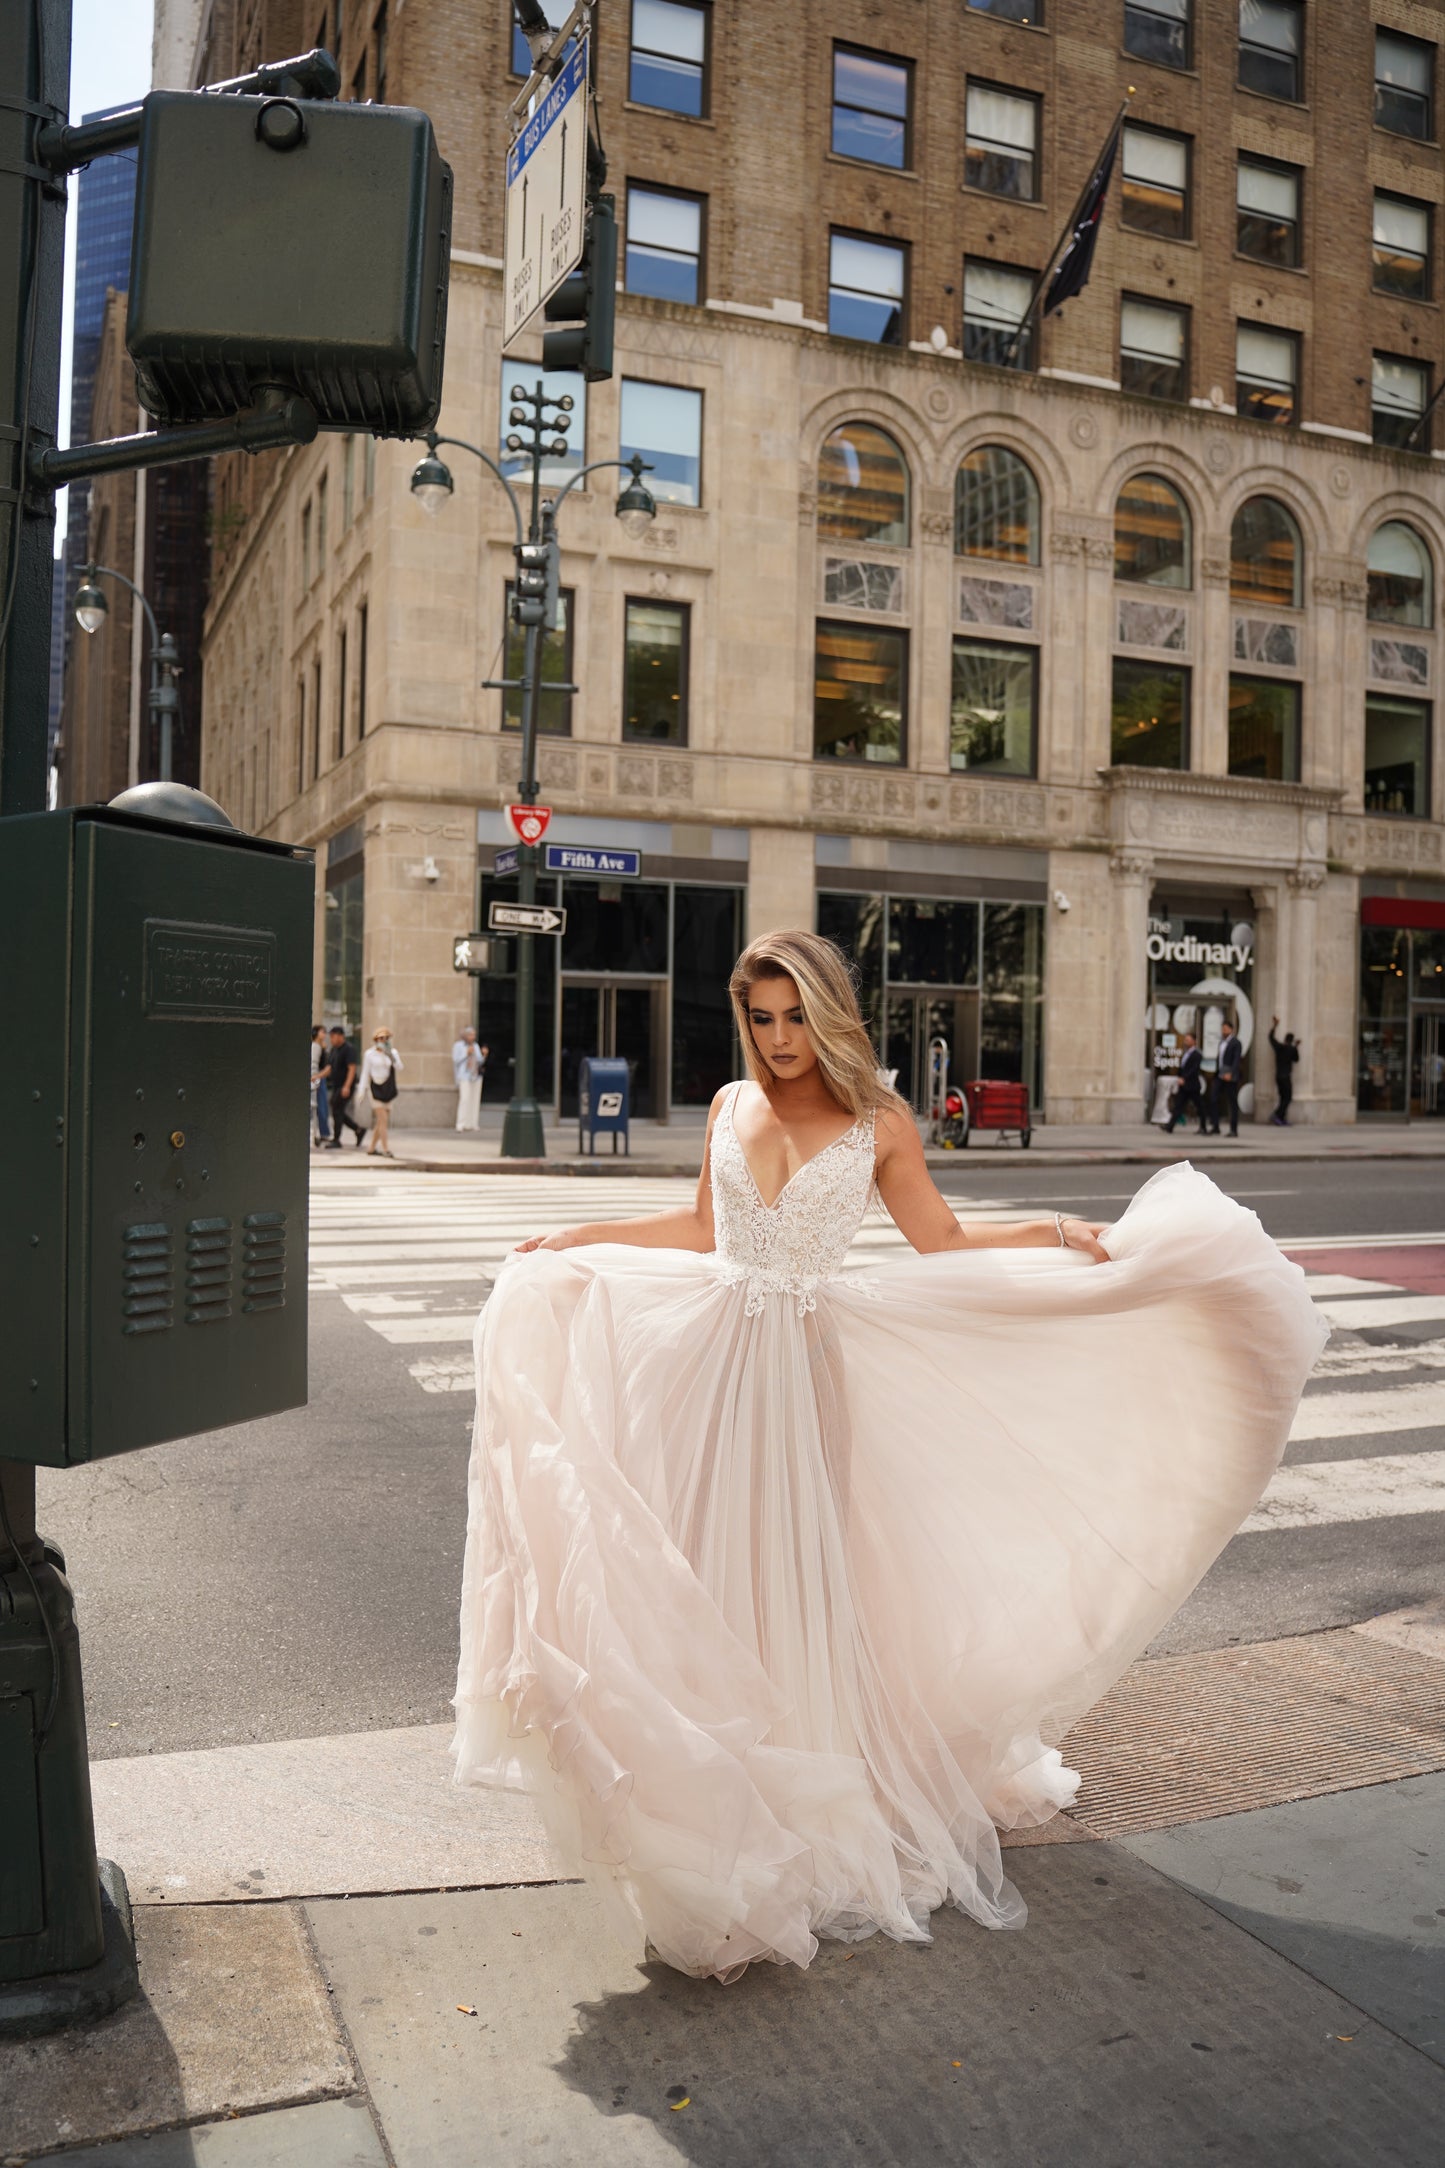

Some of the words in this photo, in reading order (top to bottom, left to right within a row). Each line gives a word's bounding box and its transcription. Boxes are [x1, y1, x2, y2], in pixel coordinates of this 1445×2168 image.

[524, 118, 540, 157] BUS
[541, 77, 567, 132] LANES
[551, 207, 572, 251] BUSES
[513, 258, 532, 298] BUSES
[551, 240, 569, 280] ONLY
[514, 288, 530, 326] ONLY
[561, 850, 596, 868] Fifth
[598, 853, 625, 871] Ave
[502, 911, 522, 922] ONE
[532, 914, 553, 924] WAY
[1147, 916, 1172, 934] The
[157, 946, 209, 968] TRAFFIC
[213, 951, 268, 975] CONTROL
[1146, 934, 1255, 972] Ordinary.
[163, 973, 193, 993] NEW
[198, 976, 228, 997] YORK
[232, 979, 261, 999] CITY
